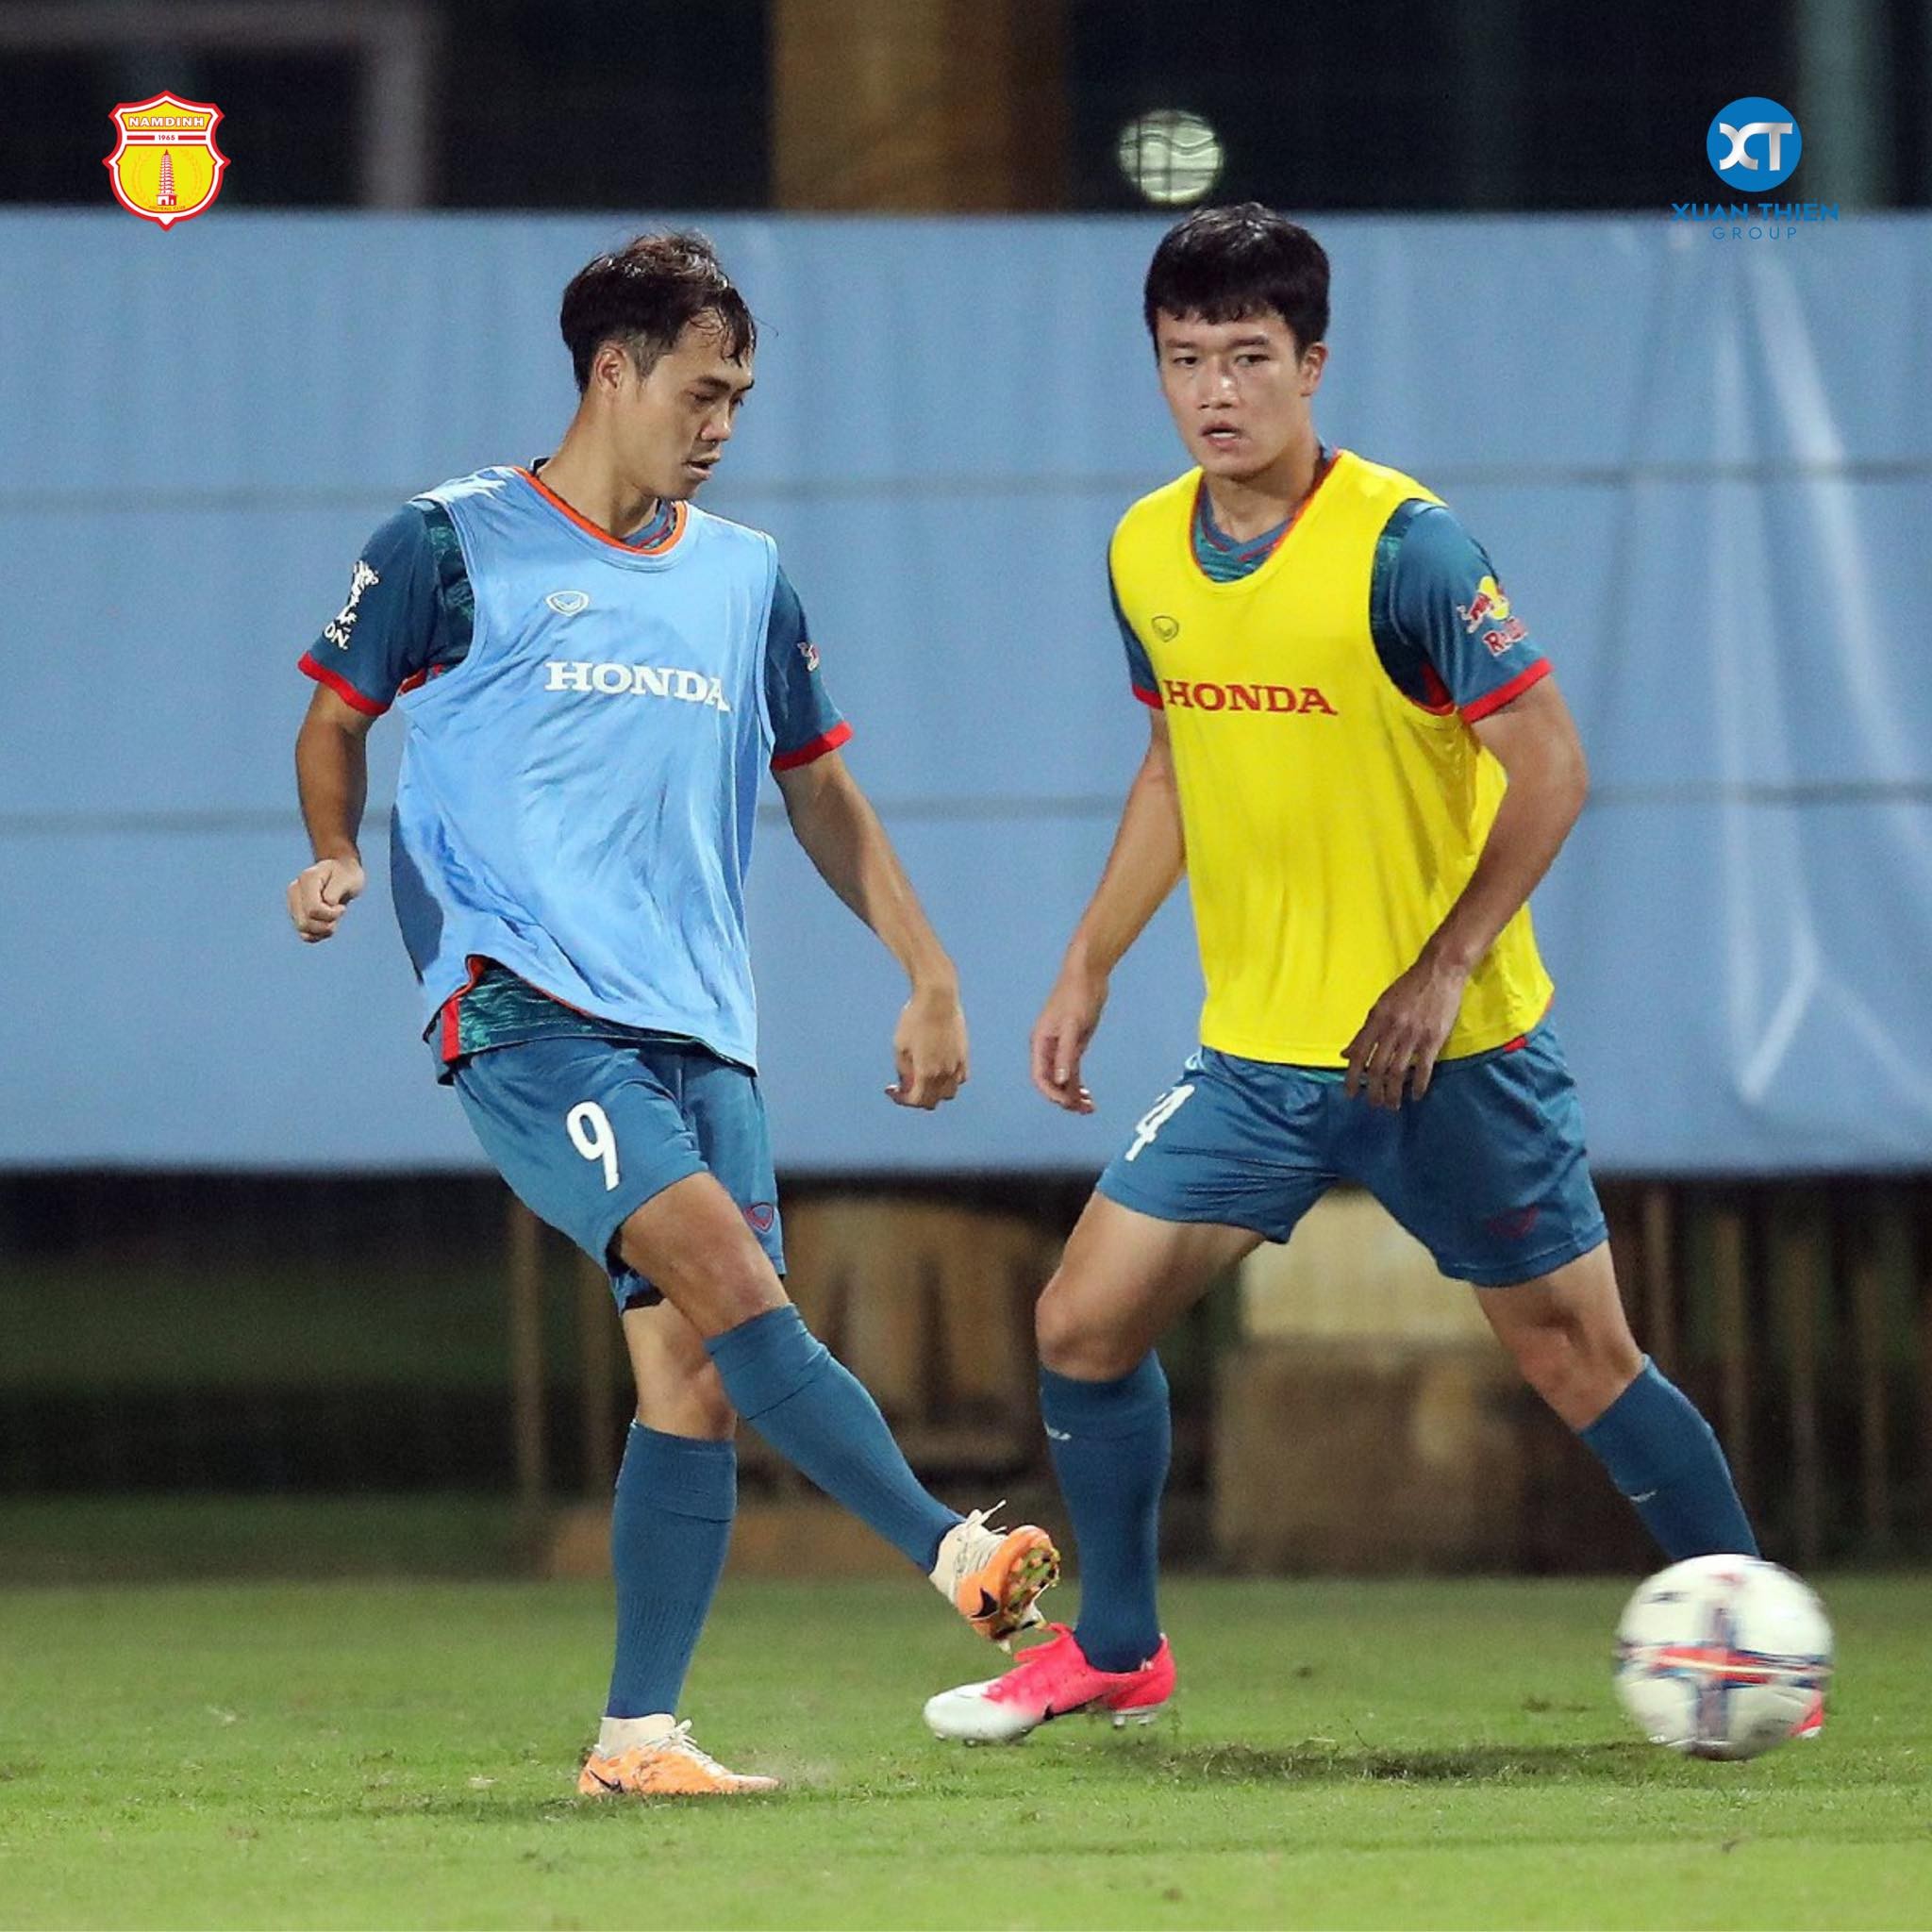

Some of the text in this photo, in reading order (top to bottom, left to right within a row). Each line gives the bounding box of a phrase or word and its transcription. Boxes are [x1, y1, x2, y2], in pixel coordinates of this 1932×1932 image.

[544, 661, 731, 712] HONDA
[1162, 679, 1339, 716] HONDA
[566, 1100, 620, 1191] 9
